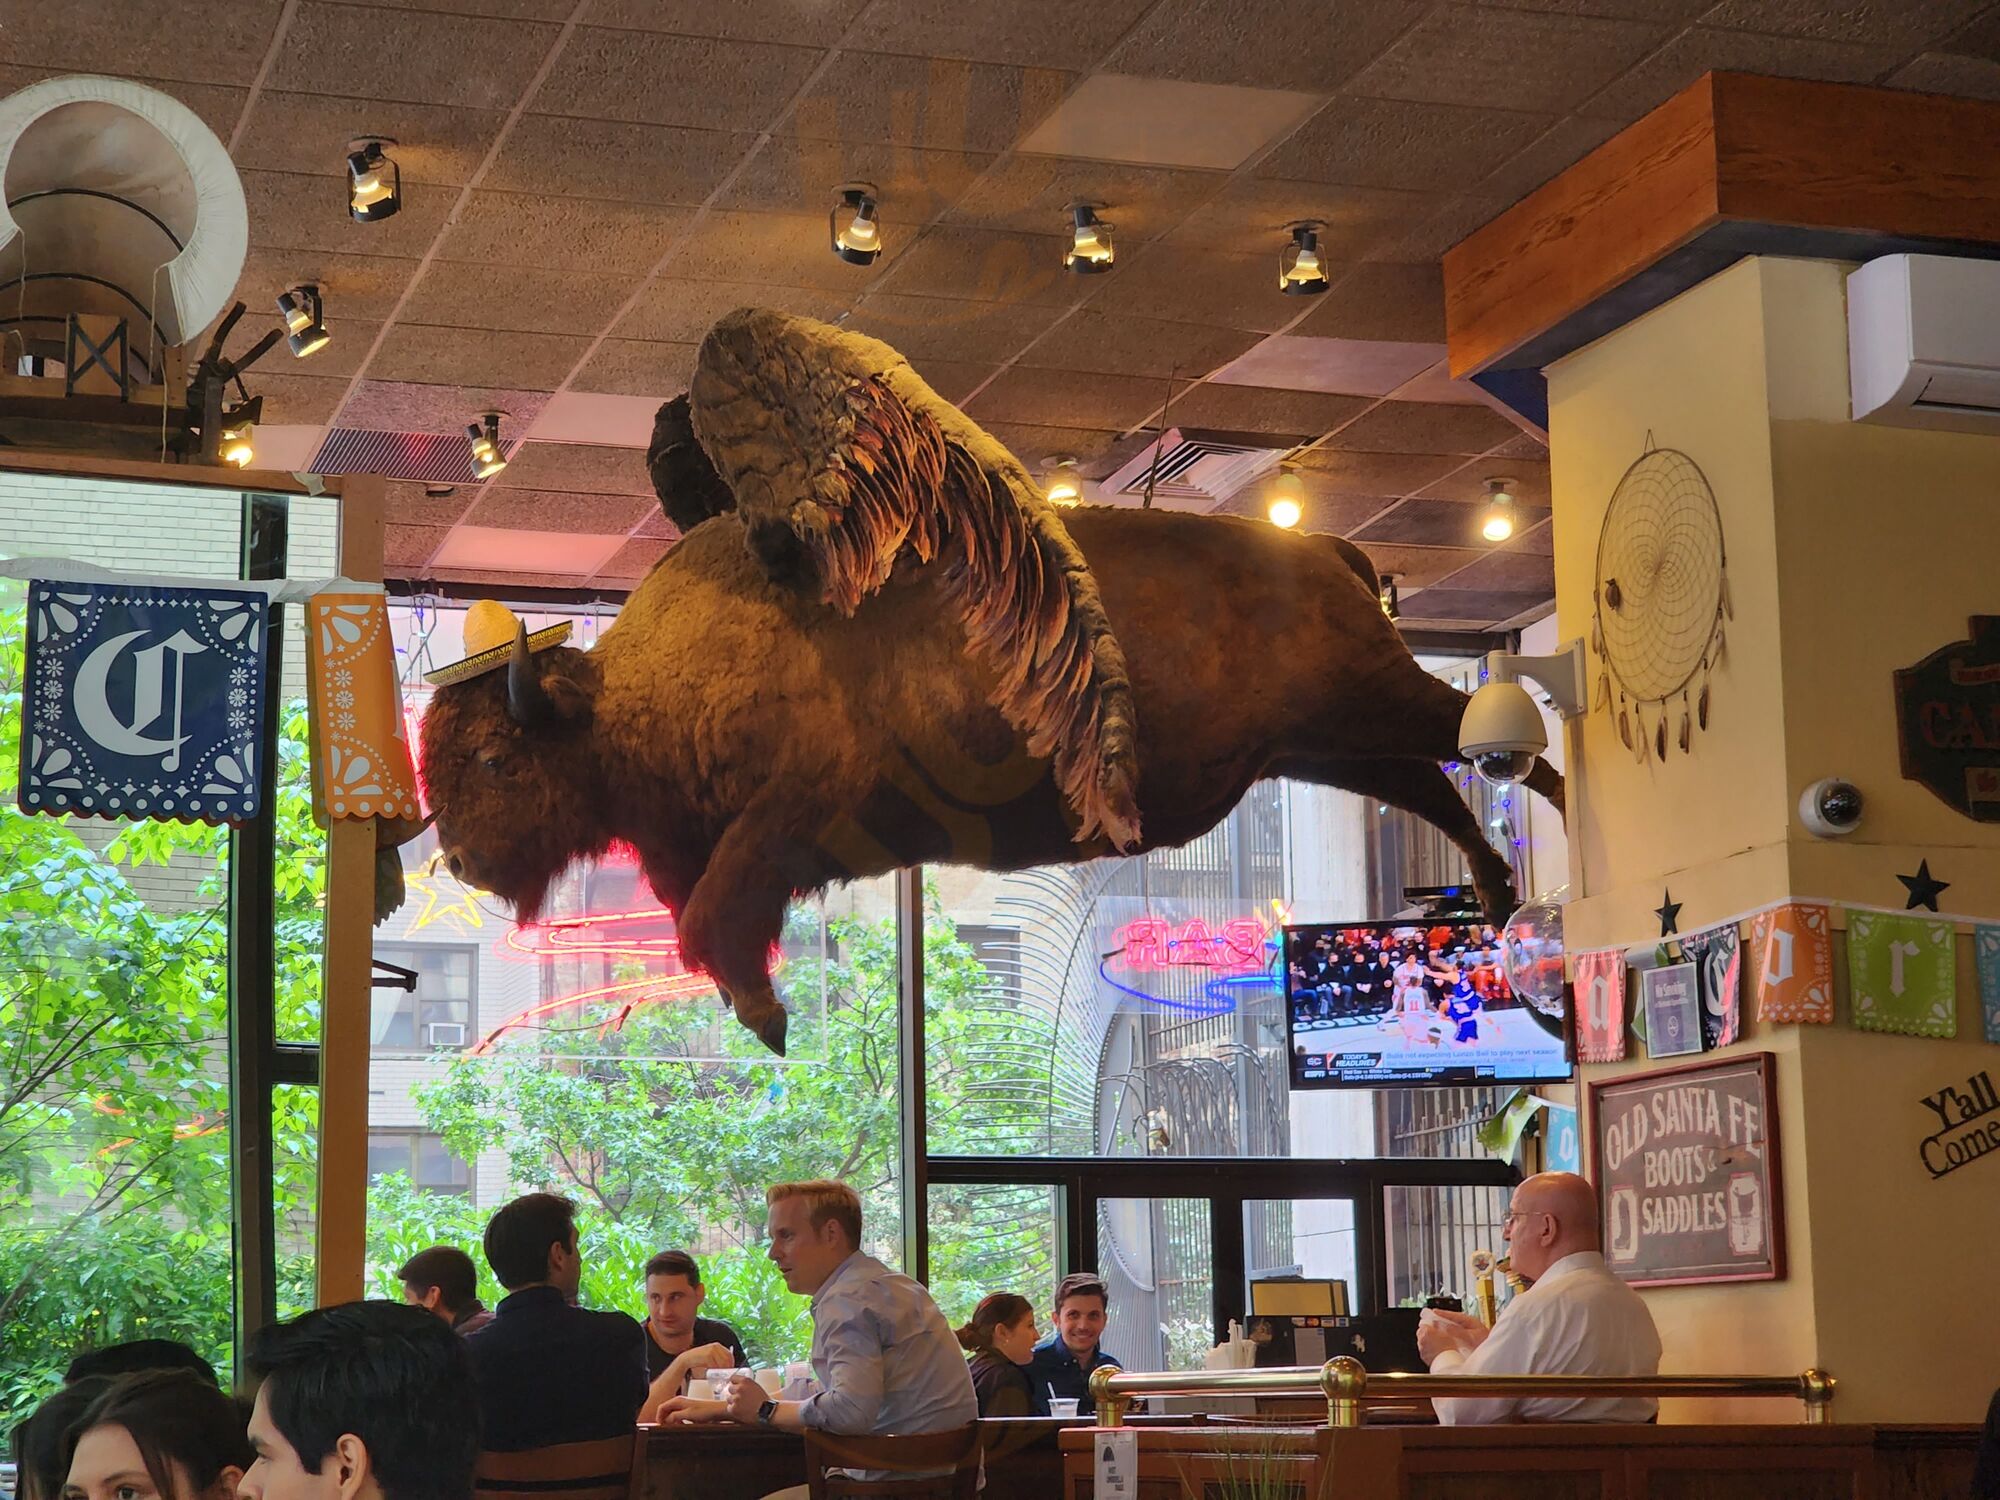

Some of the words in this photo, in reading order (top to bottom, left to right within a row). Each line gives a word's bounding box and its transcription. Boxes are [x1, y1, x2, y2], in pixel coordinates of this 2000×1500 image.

[1920, 701, 2000, 749] CA
[1335, 1058, 1377, 1067] HEADLINES
[1606, 1103, 1648, 1170] OLD
[1652, 1087, 1721, 1139] SANTA
[1727, 1094, 1761, 1159] FE
[1920, 1121, 2000, 1177] Come
[1644, 1144, 1706, 1188] BOOTS
[1641, 1191, 1727, 1235] SADDLES
